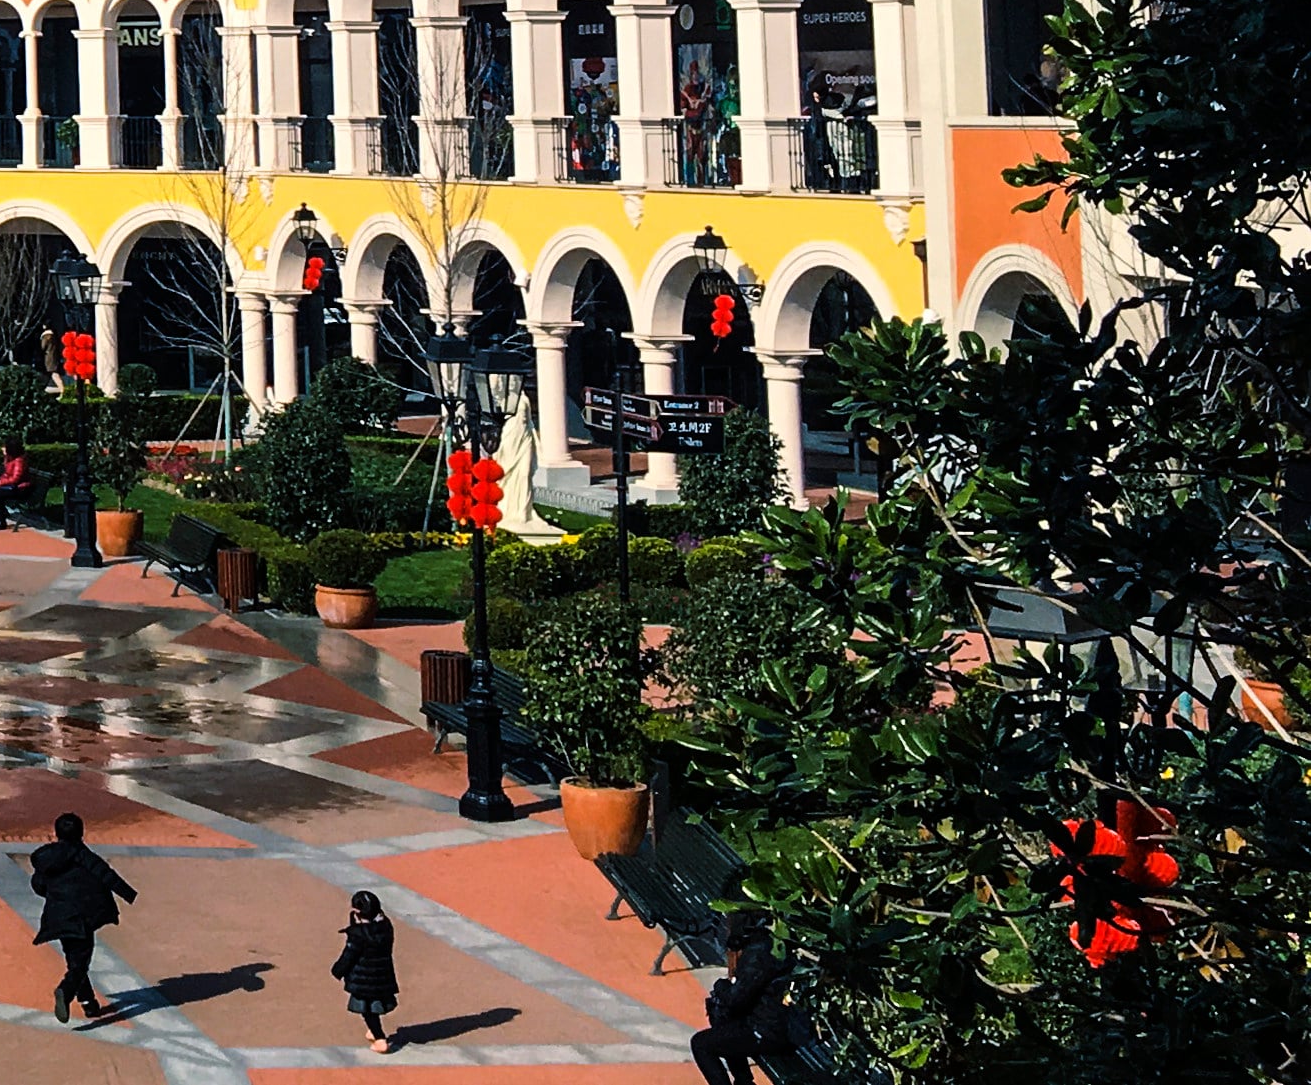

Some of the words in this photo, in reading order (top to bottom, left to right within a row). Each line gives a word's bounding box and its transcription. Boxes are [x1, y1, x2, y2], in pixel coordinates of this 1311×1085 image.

[803, 13, 830, 24] SUPER
[833, 11, 867, 23] HEROES
[117, 27, 162, 46] ANS
[825, 73, 859, 87] Opening
